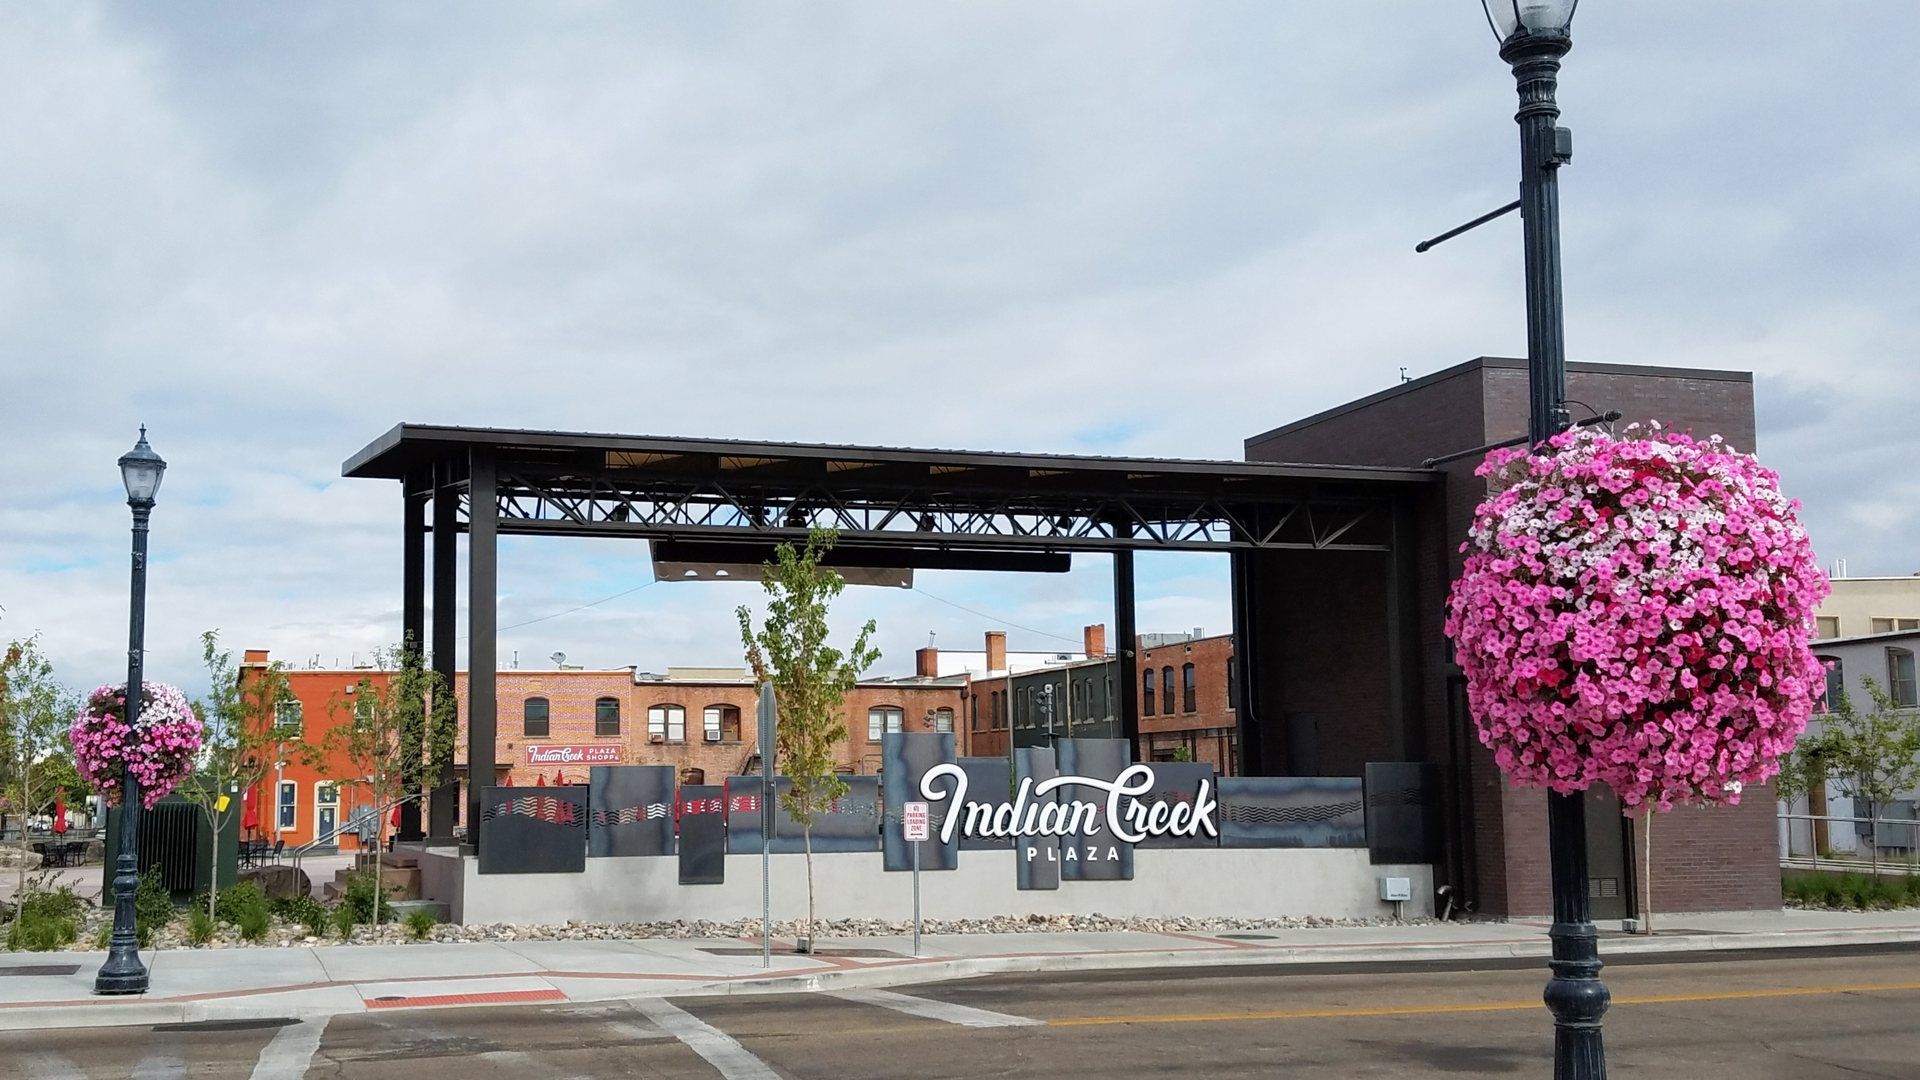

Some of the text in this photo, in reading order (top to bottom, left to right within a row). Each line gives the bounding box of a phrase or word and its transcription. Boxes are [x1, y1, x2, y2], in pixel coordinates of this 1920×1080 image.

[528, 745, 584, 763] Indian Creek
[919, 763, 1218, 844] Indian Creek
[1026, 846, 1119, 862] PLAZA
